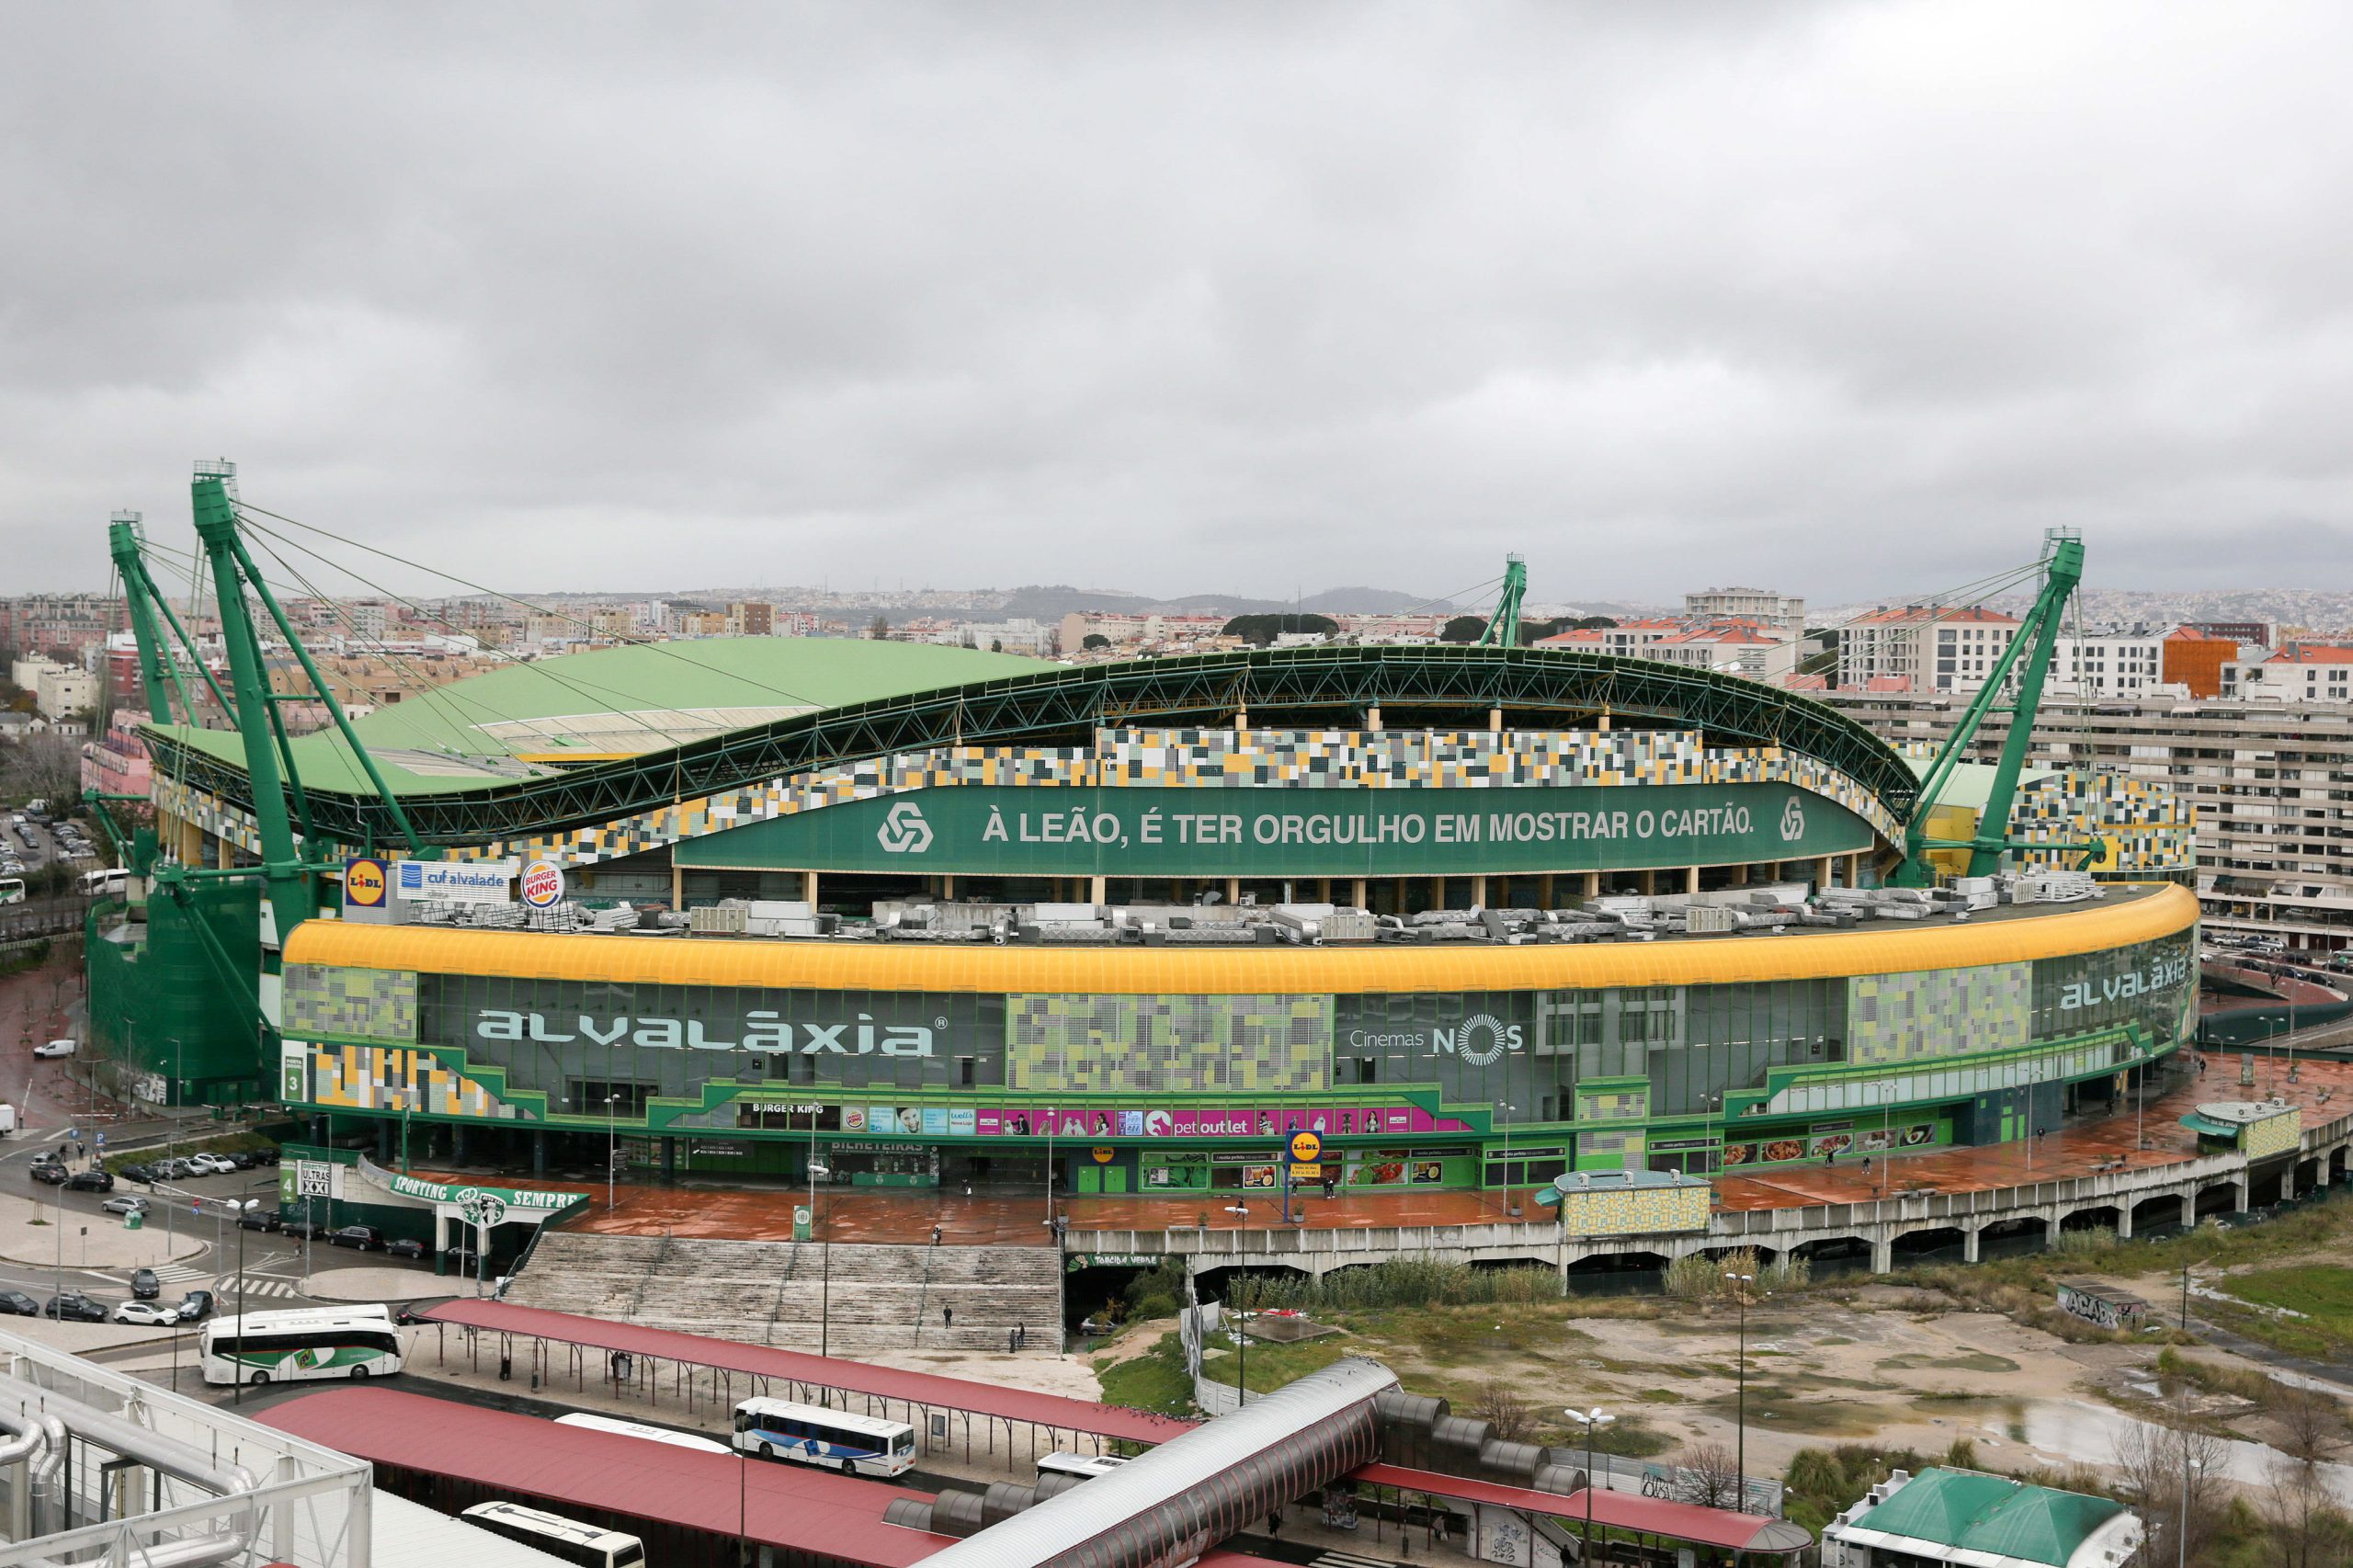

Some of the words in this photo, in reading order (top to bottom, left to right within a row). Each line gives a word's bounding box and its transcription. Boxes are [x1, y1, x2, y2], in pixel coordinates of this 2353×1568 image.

[982, 804, 1009, 842] À
[1018, 806, 1129, 849] LEÃO,
[1141, 807, 1163, 843] É
[1172, 813, 1243, 844] TER
[1253, 813, 1426, 844] ORGULHO
[1435, 814, 1480, 843] EM
[1489, 811, 1629, 842] MOSTRAR
[1635, 810, 1654, 838] O
[1660, 801, 1754, 837] CARTÃO.
[350, 873, 381, 889] LIDL
[427, 870, 448, 884] cuf
[449, 871, 505, 887] alvalade
[525, 870, 556, 885] BURGER
[526, 880, 558, 898] KING
[1350, 1029, 1425, 1047] Cinemas
[1433, 1014, 1523, 1066] NOS
[289, 1076, 298, 1091] 3
[1174, 1120, 1198, 1136] pet
[1199, 1119, 1248, 1133] outlet
[97, 1133, 104, 1142] P
[1293, 1142, 1318, 1151] LIDL
[303, 1170, 330, 1181] ULTRAS
[283, 1178, 292, 1192] 4
[303, 1181, 330, 1194] XXI
[394, 1176, 448, 1200] SPORTING
[513, 1190, 579, 1209] SEMPRE
